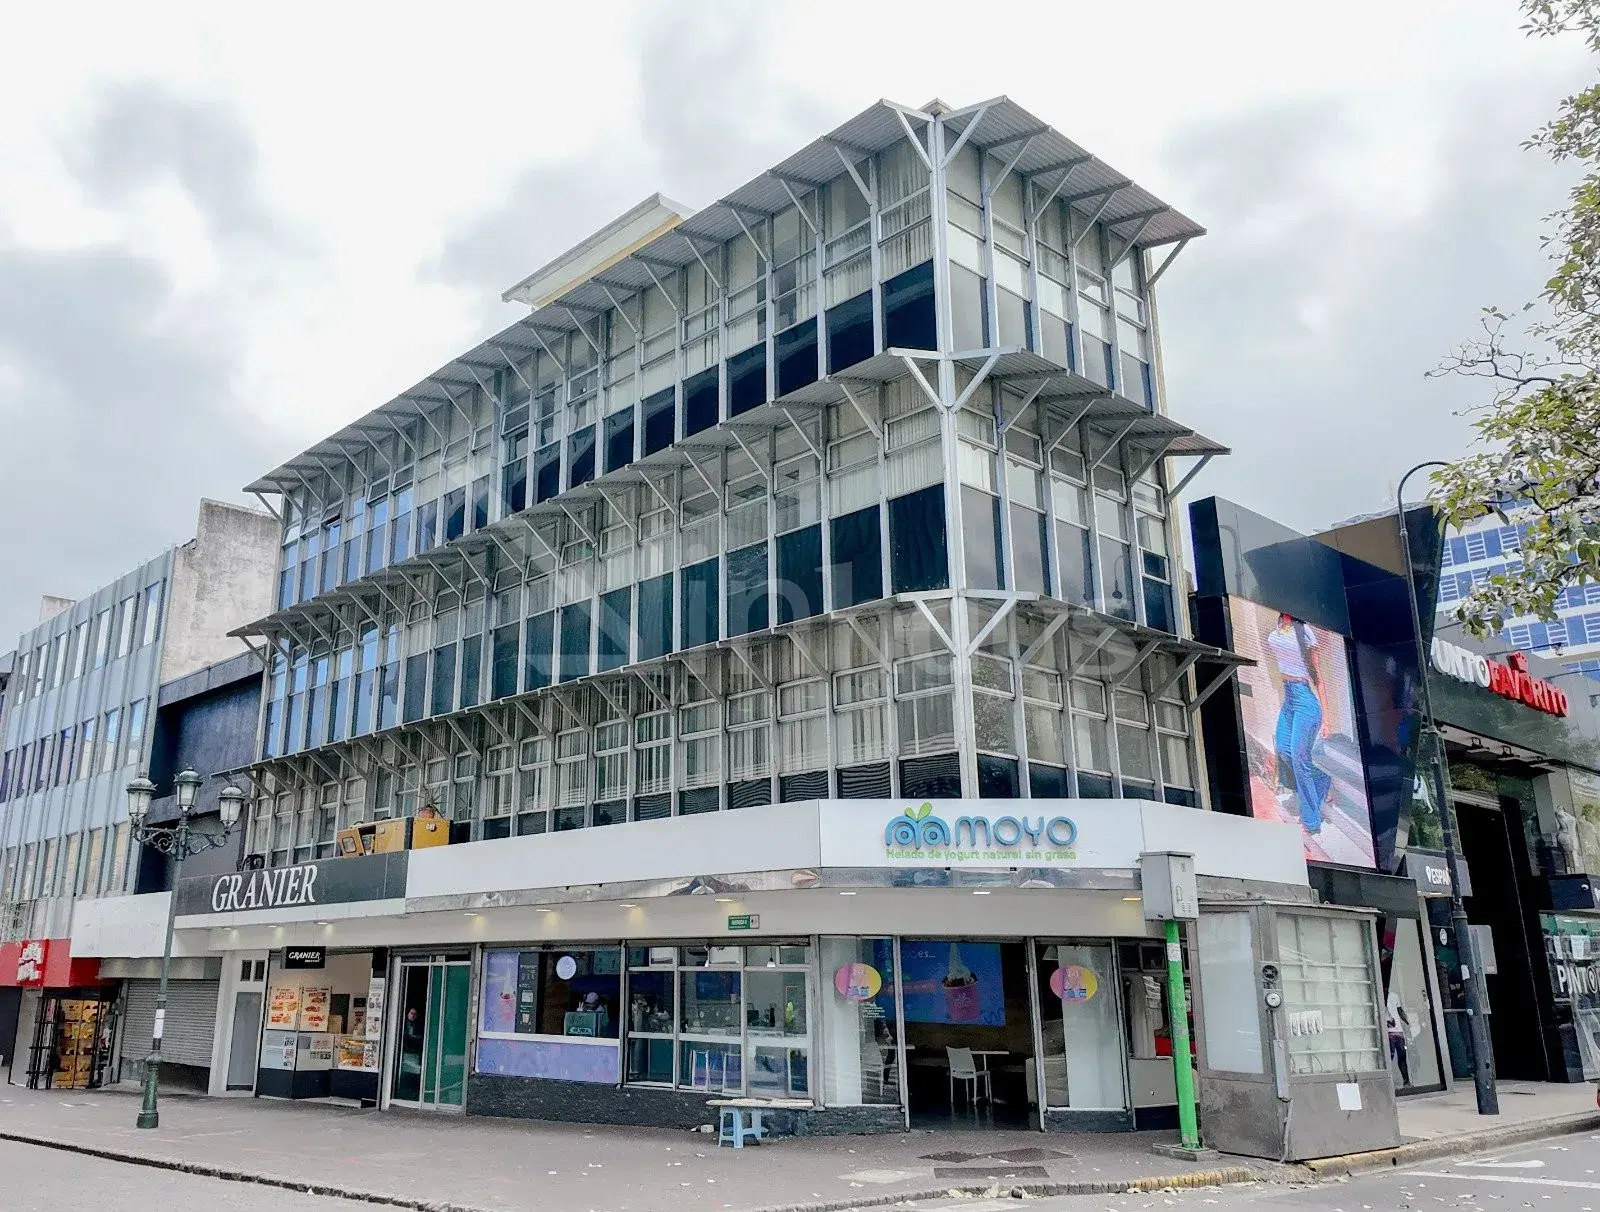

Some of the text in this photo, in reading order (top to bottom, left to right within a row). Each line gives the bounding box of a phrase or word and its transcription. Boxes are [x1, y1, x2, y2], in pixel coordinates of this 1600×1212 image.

[1429, 636, 1569, 717] UNTO FAVORITO
[886, 849, 1077, 861] Helado de yogurt natural sin grasa
[212, 864, 318, 912] GRANIER
[288, 951, 321, 960] GRANIER
